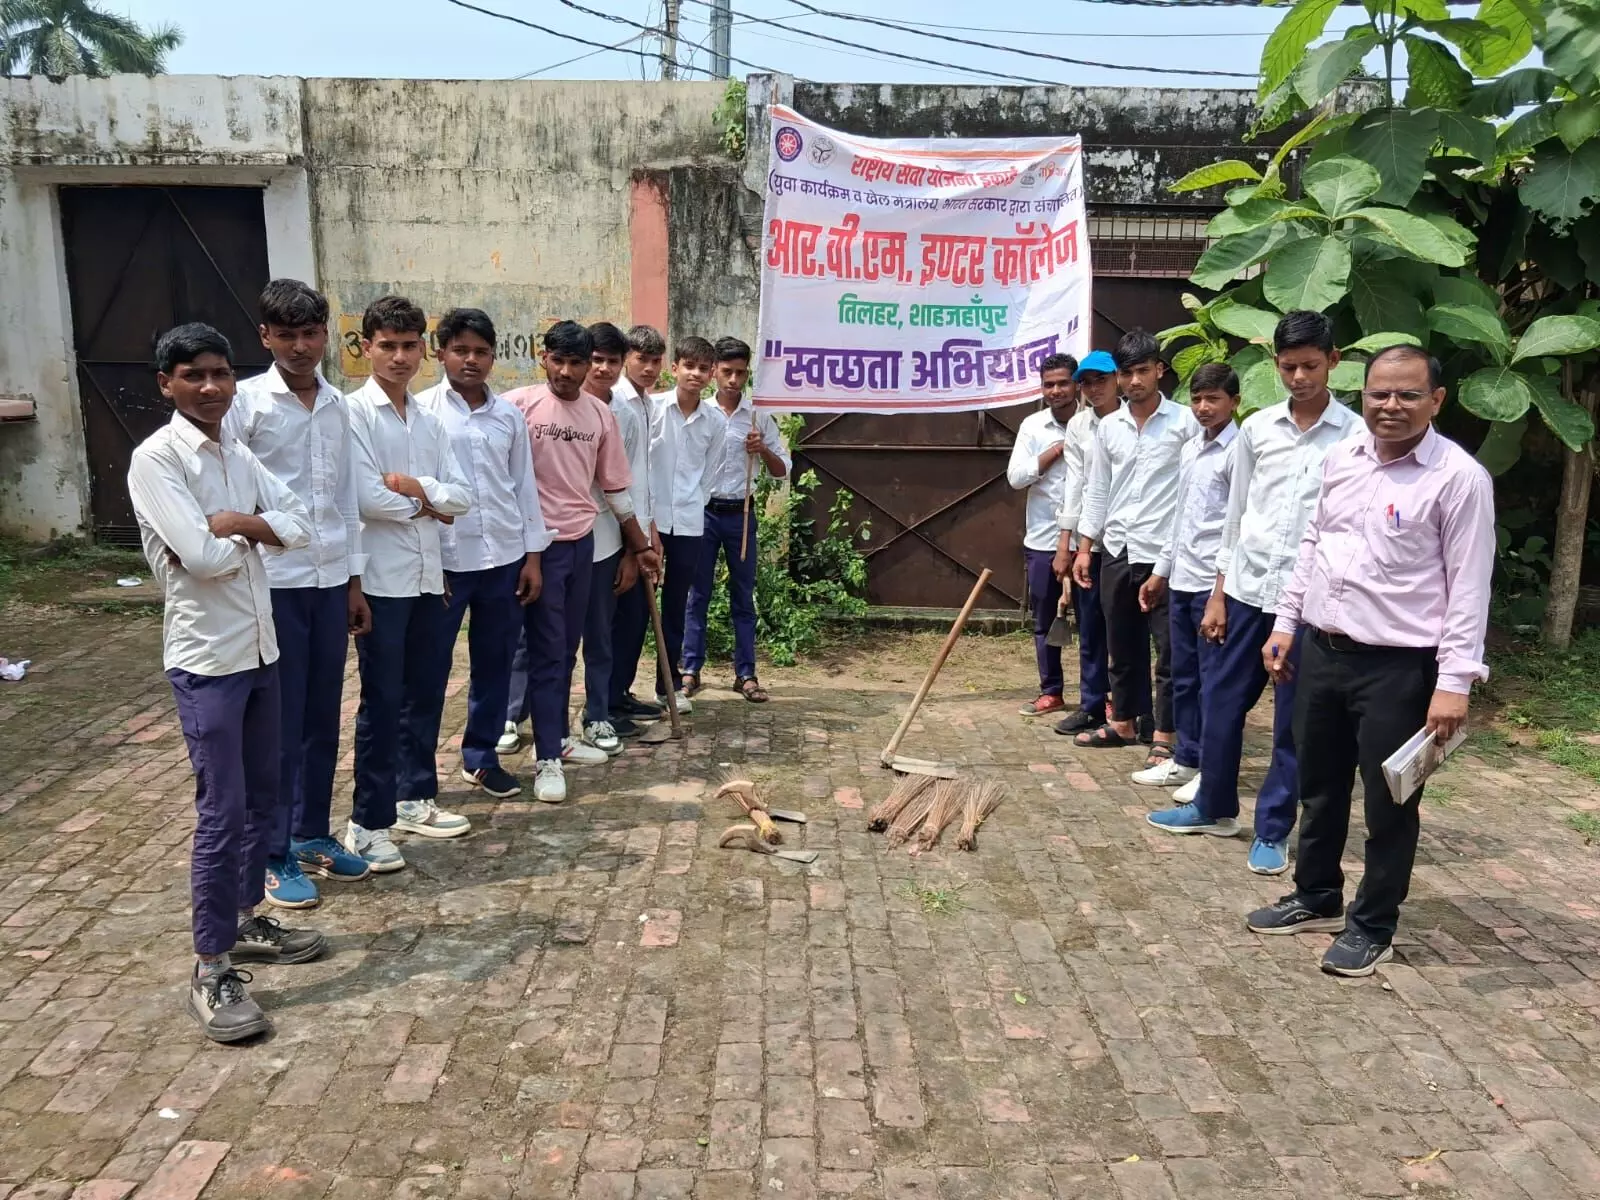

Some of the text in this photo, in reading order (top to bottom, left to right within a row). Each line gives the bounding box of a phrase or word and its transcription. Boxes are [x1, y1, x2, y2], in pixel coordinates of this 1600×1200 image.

[769, 169, 797, 196] (युवा
[800, 179, 850, 201] कार्यक्रम
[854, 190, 863, 202] व
[864, 191, 890, 206] खेल
[942, 198, 966, 209] भारत
[968, 198, 1007, 212] सरकार
[1009, 200, 1031, 216] द्वारा
[920, 234, 988, 286] इण्टर
[991, 219, 1078, 286] कॉलेज
[838, 293, 1009, 334] तिलहर, शाहजहाँपुर
